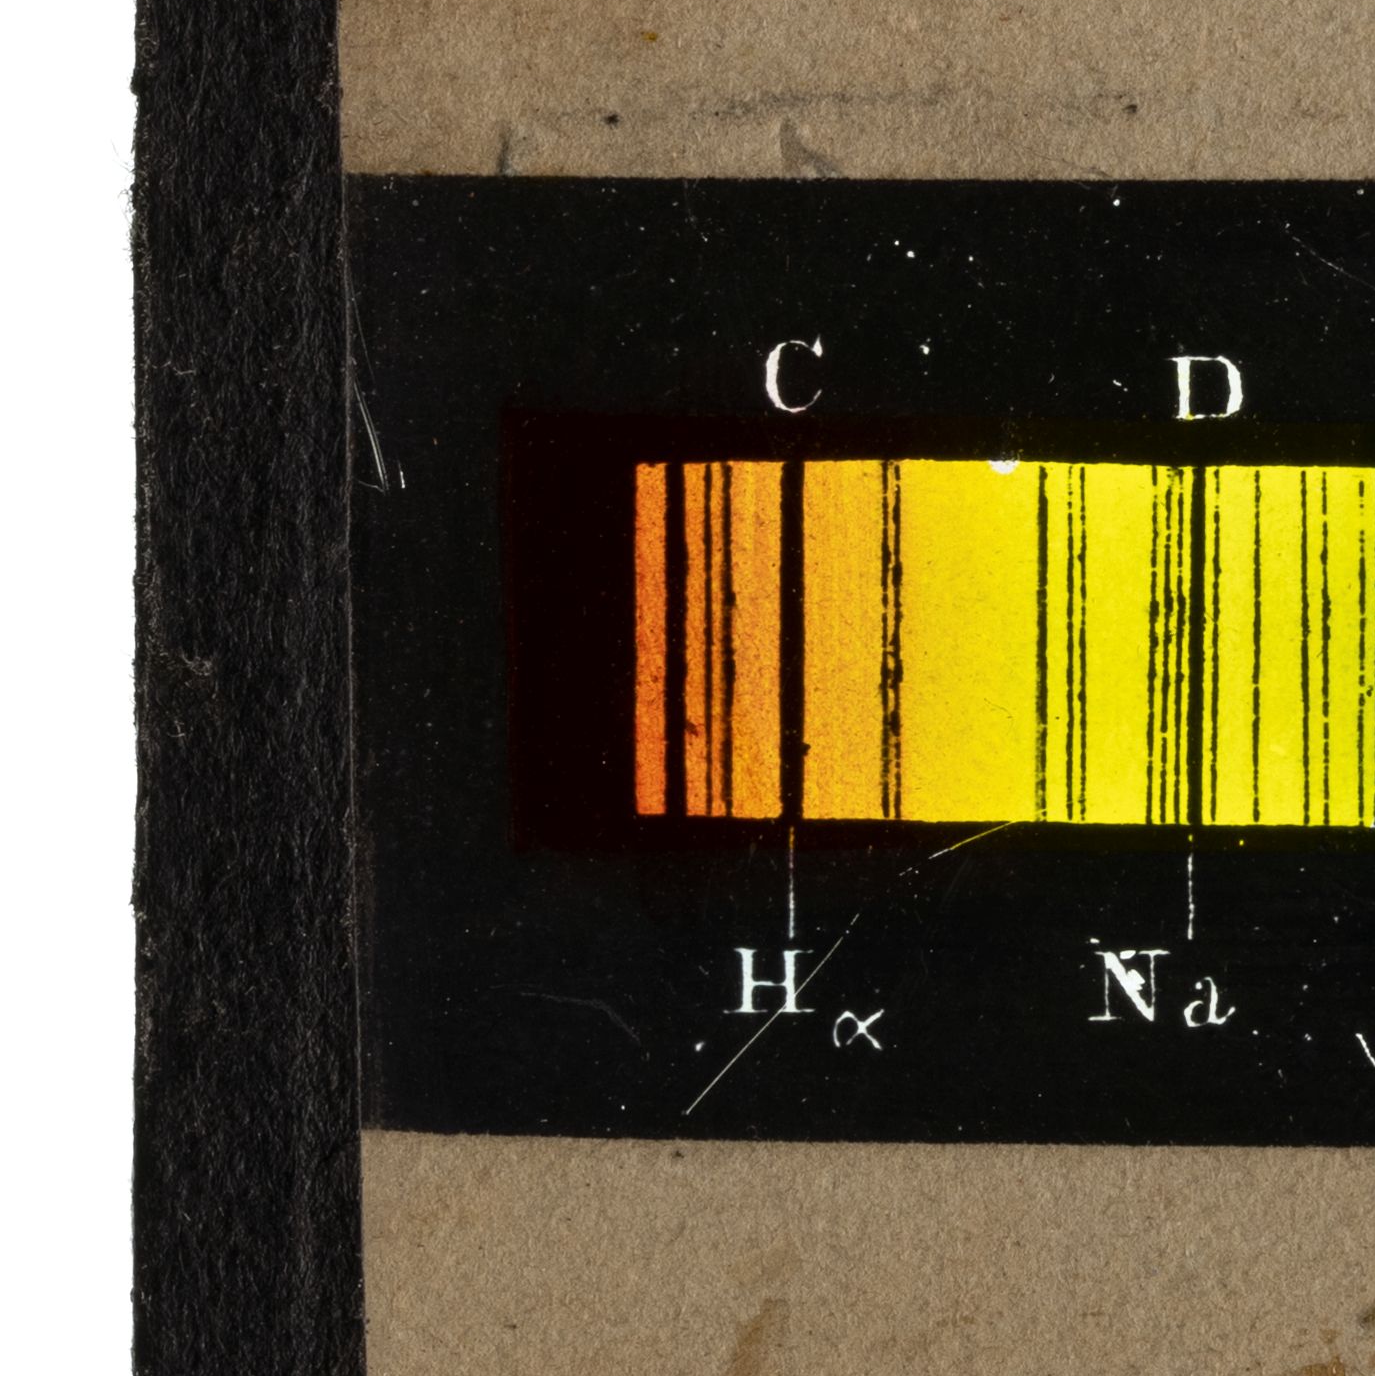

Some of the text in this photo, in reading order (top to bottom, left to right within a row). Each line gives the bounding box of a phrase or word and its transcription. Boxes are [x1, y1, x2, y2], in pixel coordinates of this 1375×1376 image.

[758, 337, 825, 414] C
[1171, 353, 1245, 422] D
[1087, 947, 1237, 1029] Na
